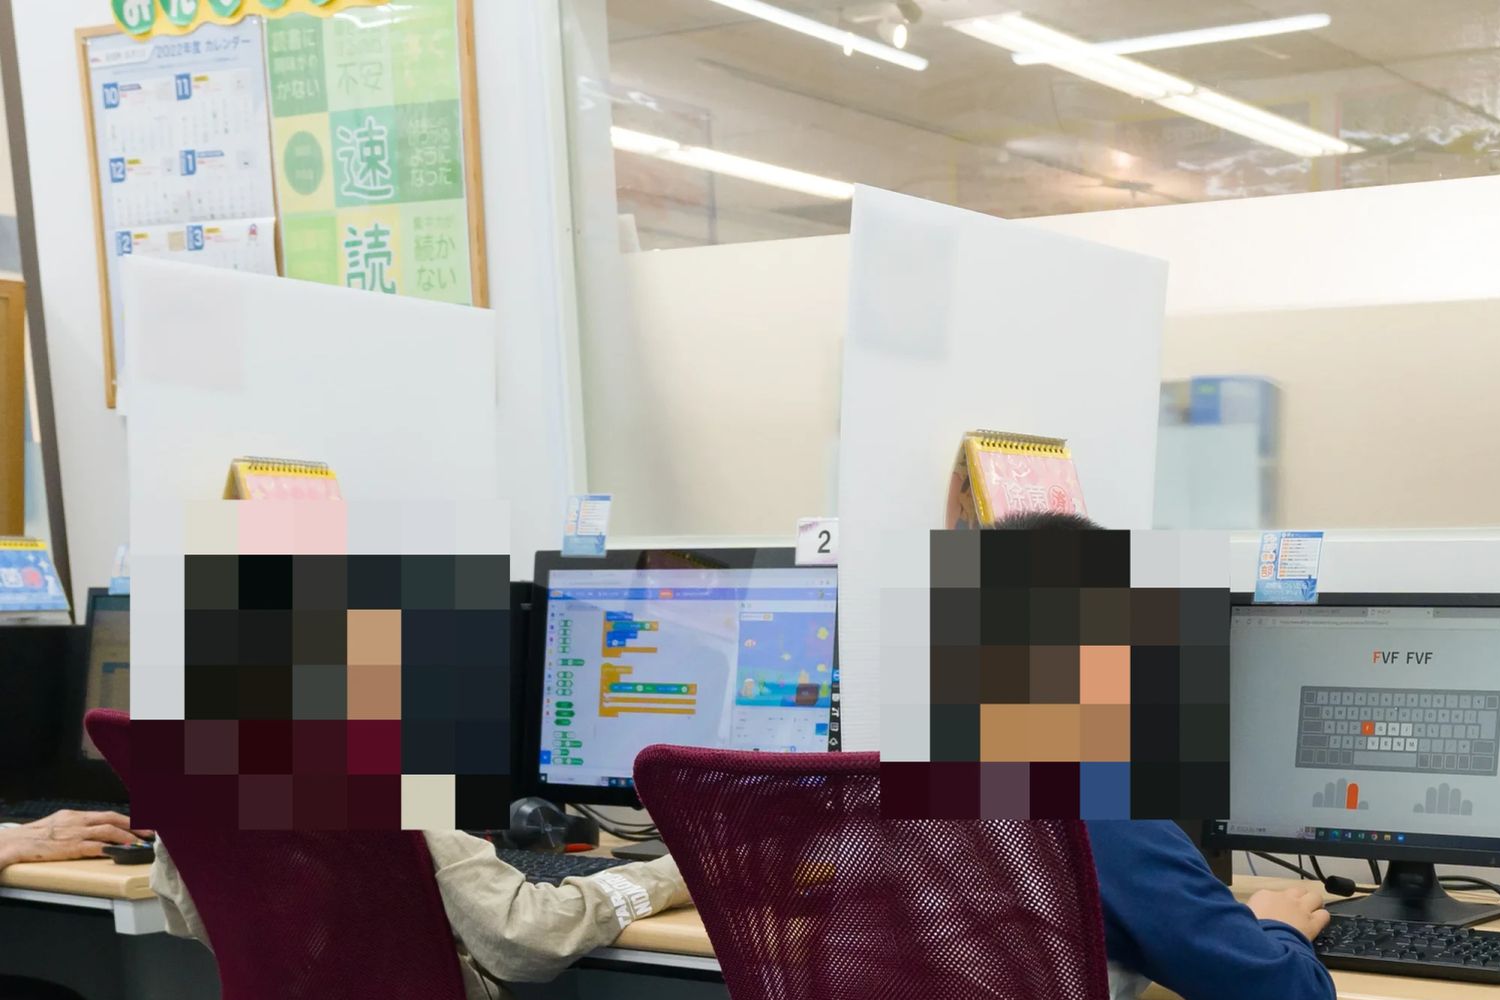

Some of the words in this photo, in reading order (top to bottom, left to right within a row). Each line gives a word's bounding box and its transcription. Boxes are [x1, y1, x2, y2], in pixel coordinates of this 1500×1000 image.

[817, 530, 831, 553] 2
[1372, 651, 1399, 665] FVF
[1406, 651, 1433, 665] FVF
